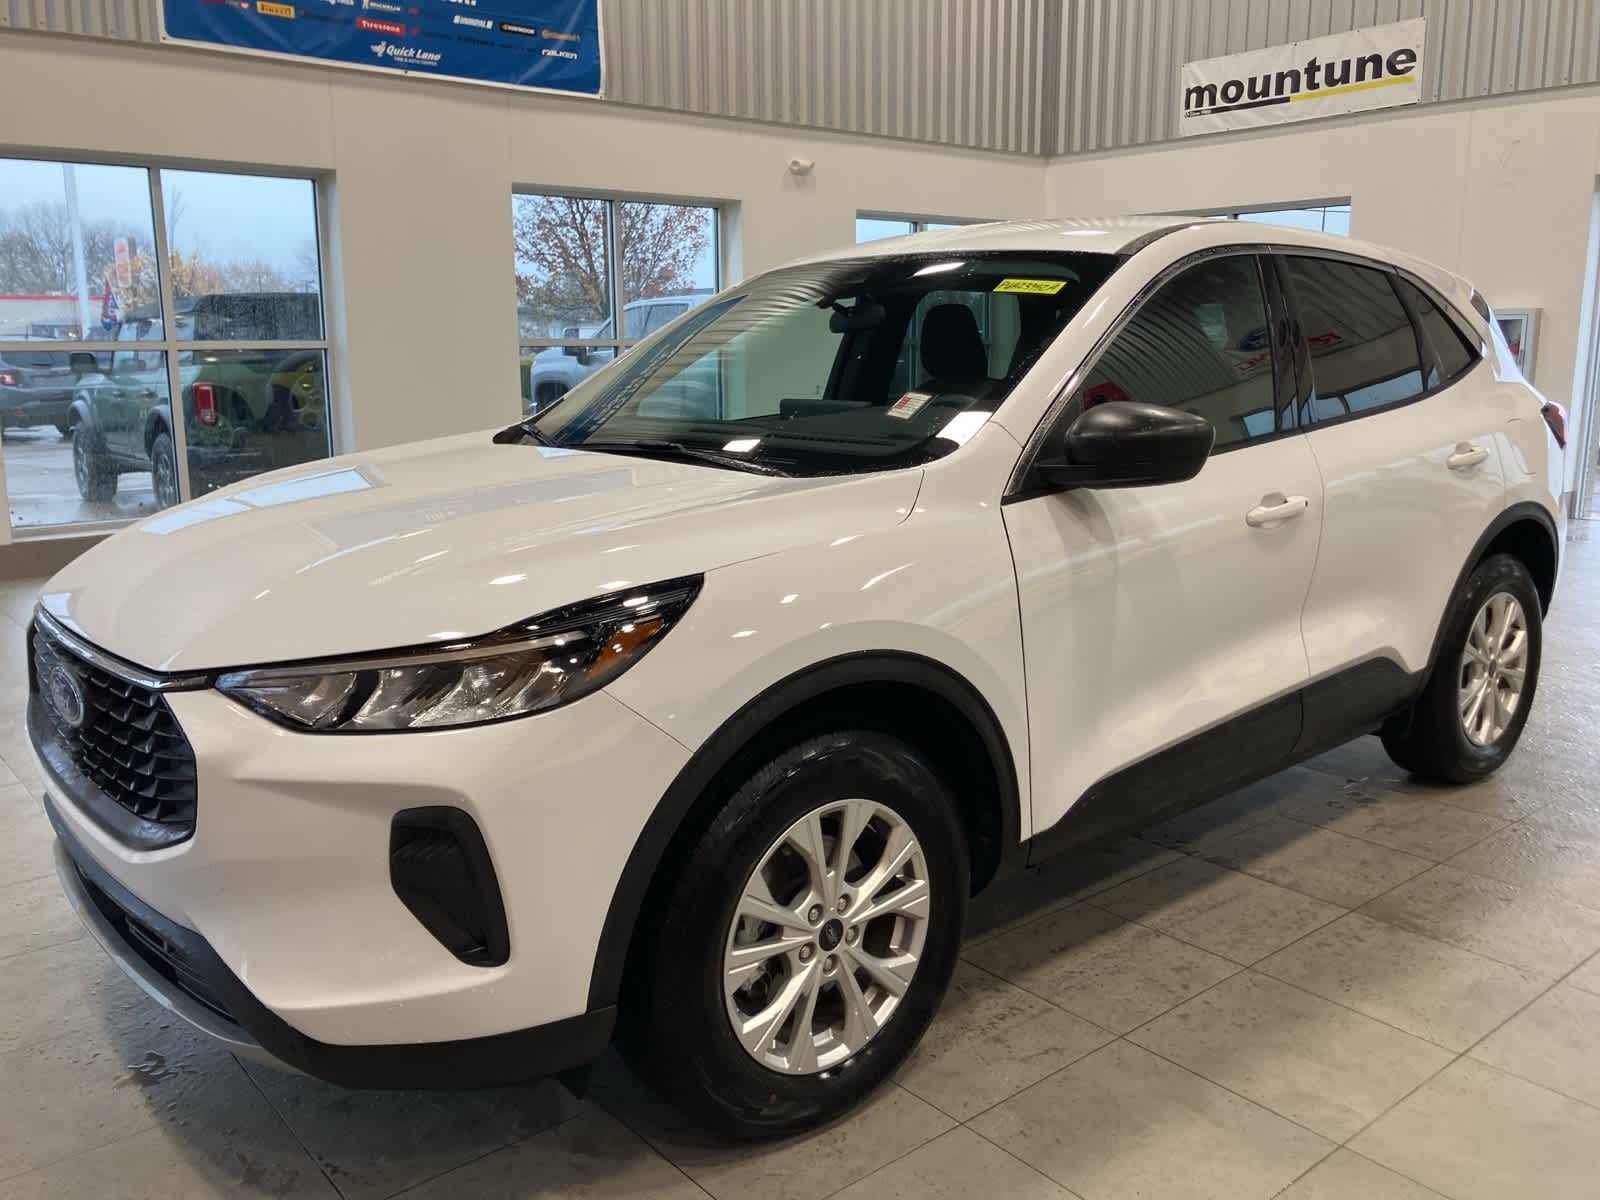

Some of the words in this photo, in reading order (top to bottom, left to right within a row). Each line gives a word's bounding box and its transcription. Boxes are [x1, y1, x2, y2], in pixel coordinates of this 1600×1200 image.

[361, 20, 400, 32] Firestone
[386, 44, 416, 57] Quick
[416, 49, 442, 61] Lane
[1184, 48, 1417, 110] mountune
